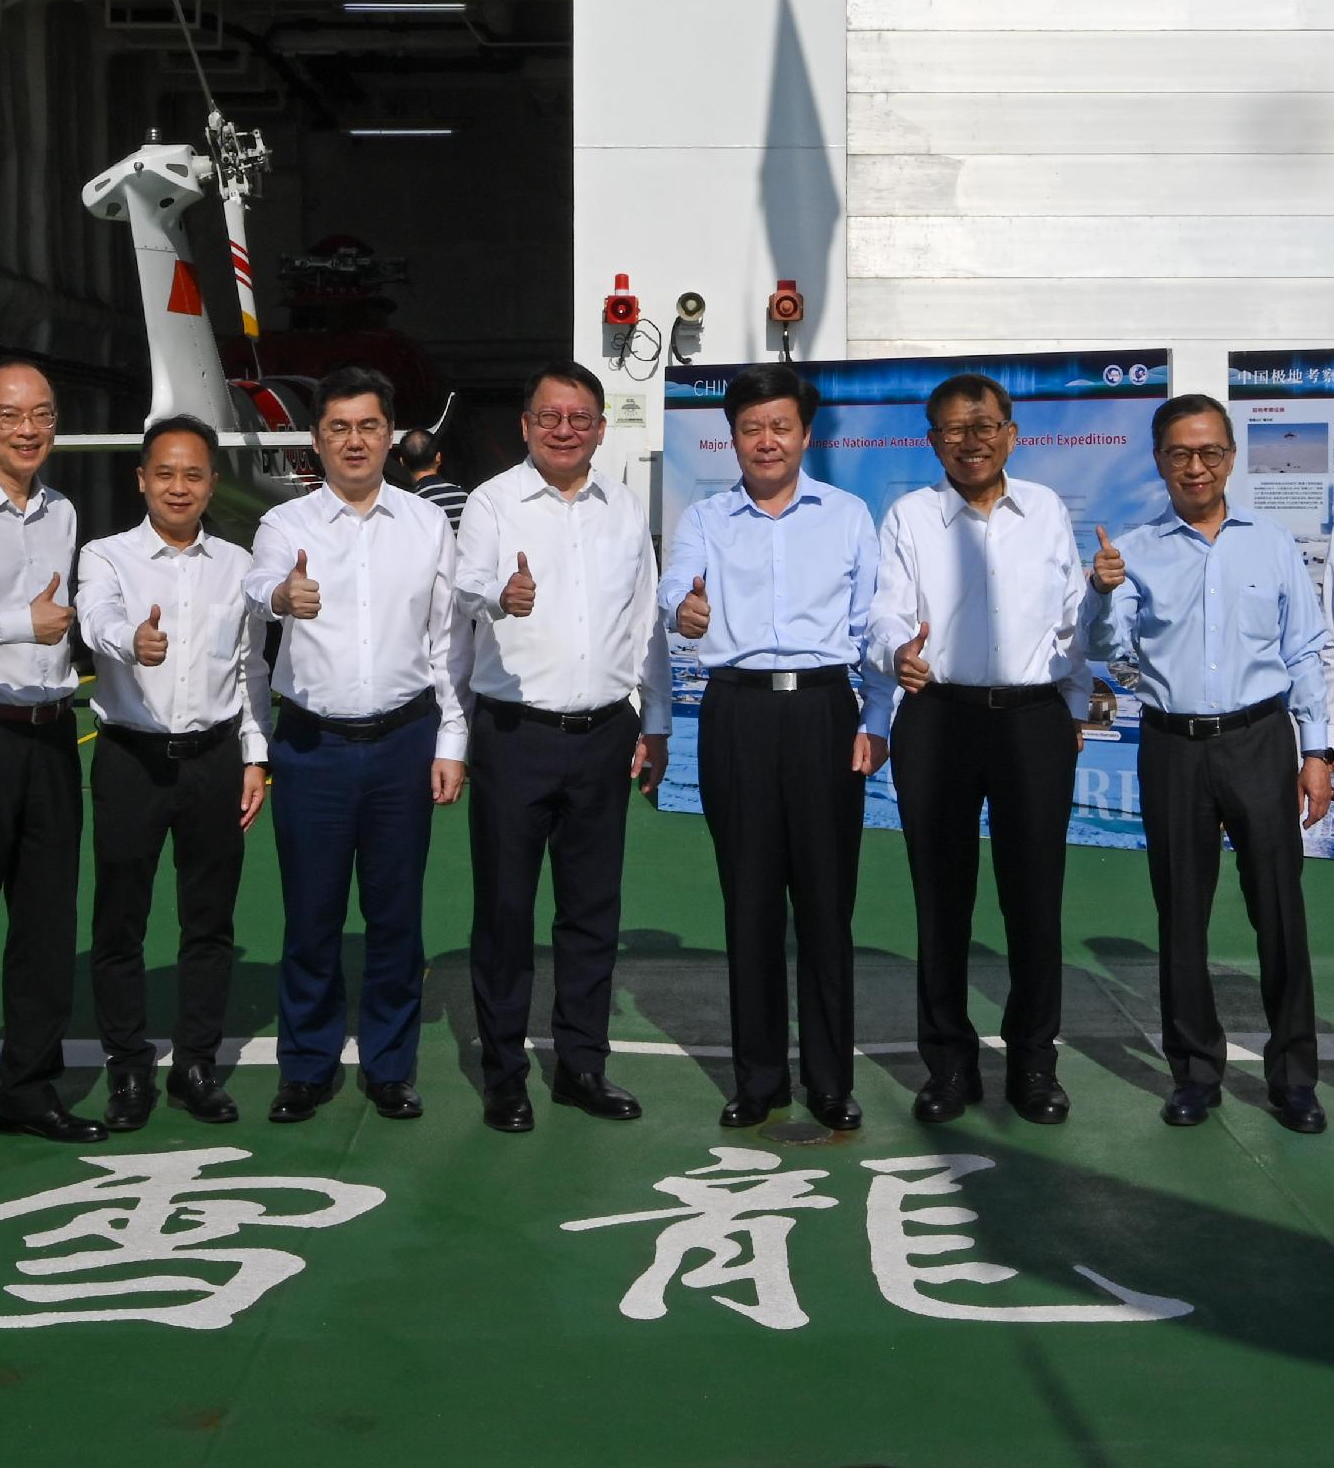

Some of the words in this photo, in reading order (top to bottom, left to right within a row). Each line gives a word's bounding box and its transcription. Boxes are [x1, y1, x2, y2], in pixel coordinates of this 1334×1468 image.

[699, 438, 728, 452] Major
[842, 435, 887, 448] National
[890, 436, 931, 447] Antarct
[1015, 434, 1053, 446] search
[1057, 433, 1127, 446] Expeditions
